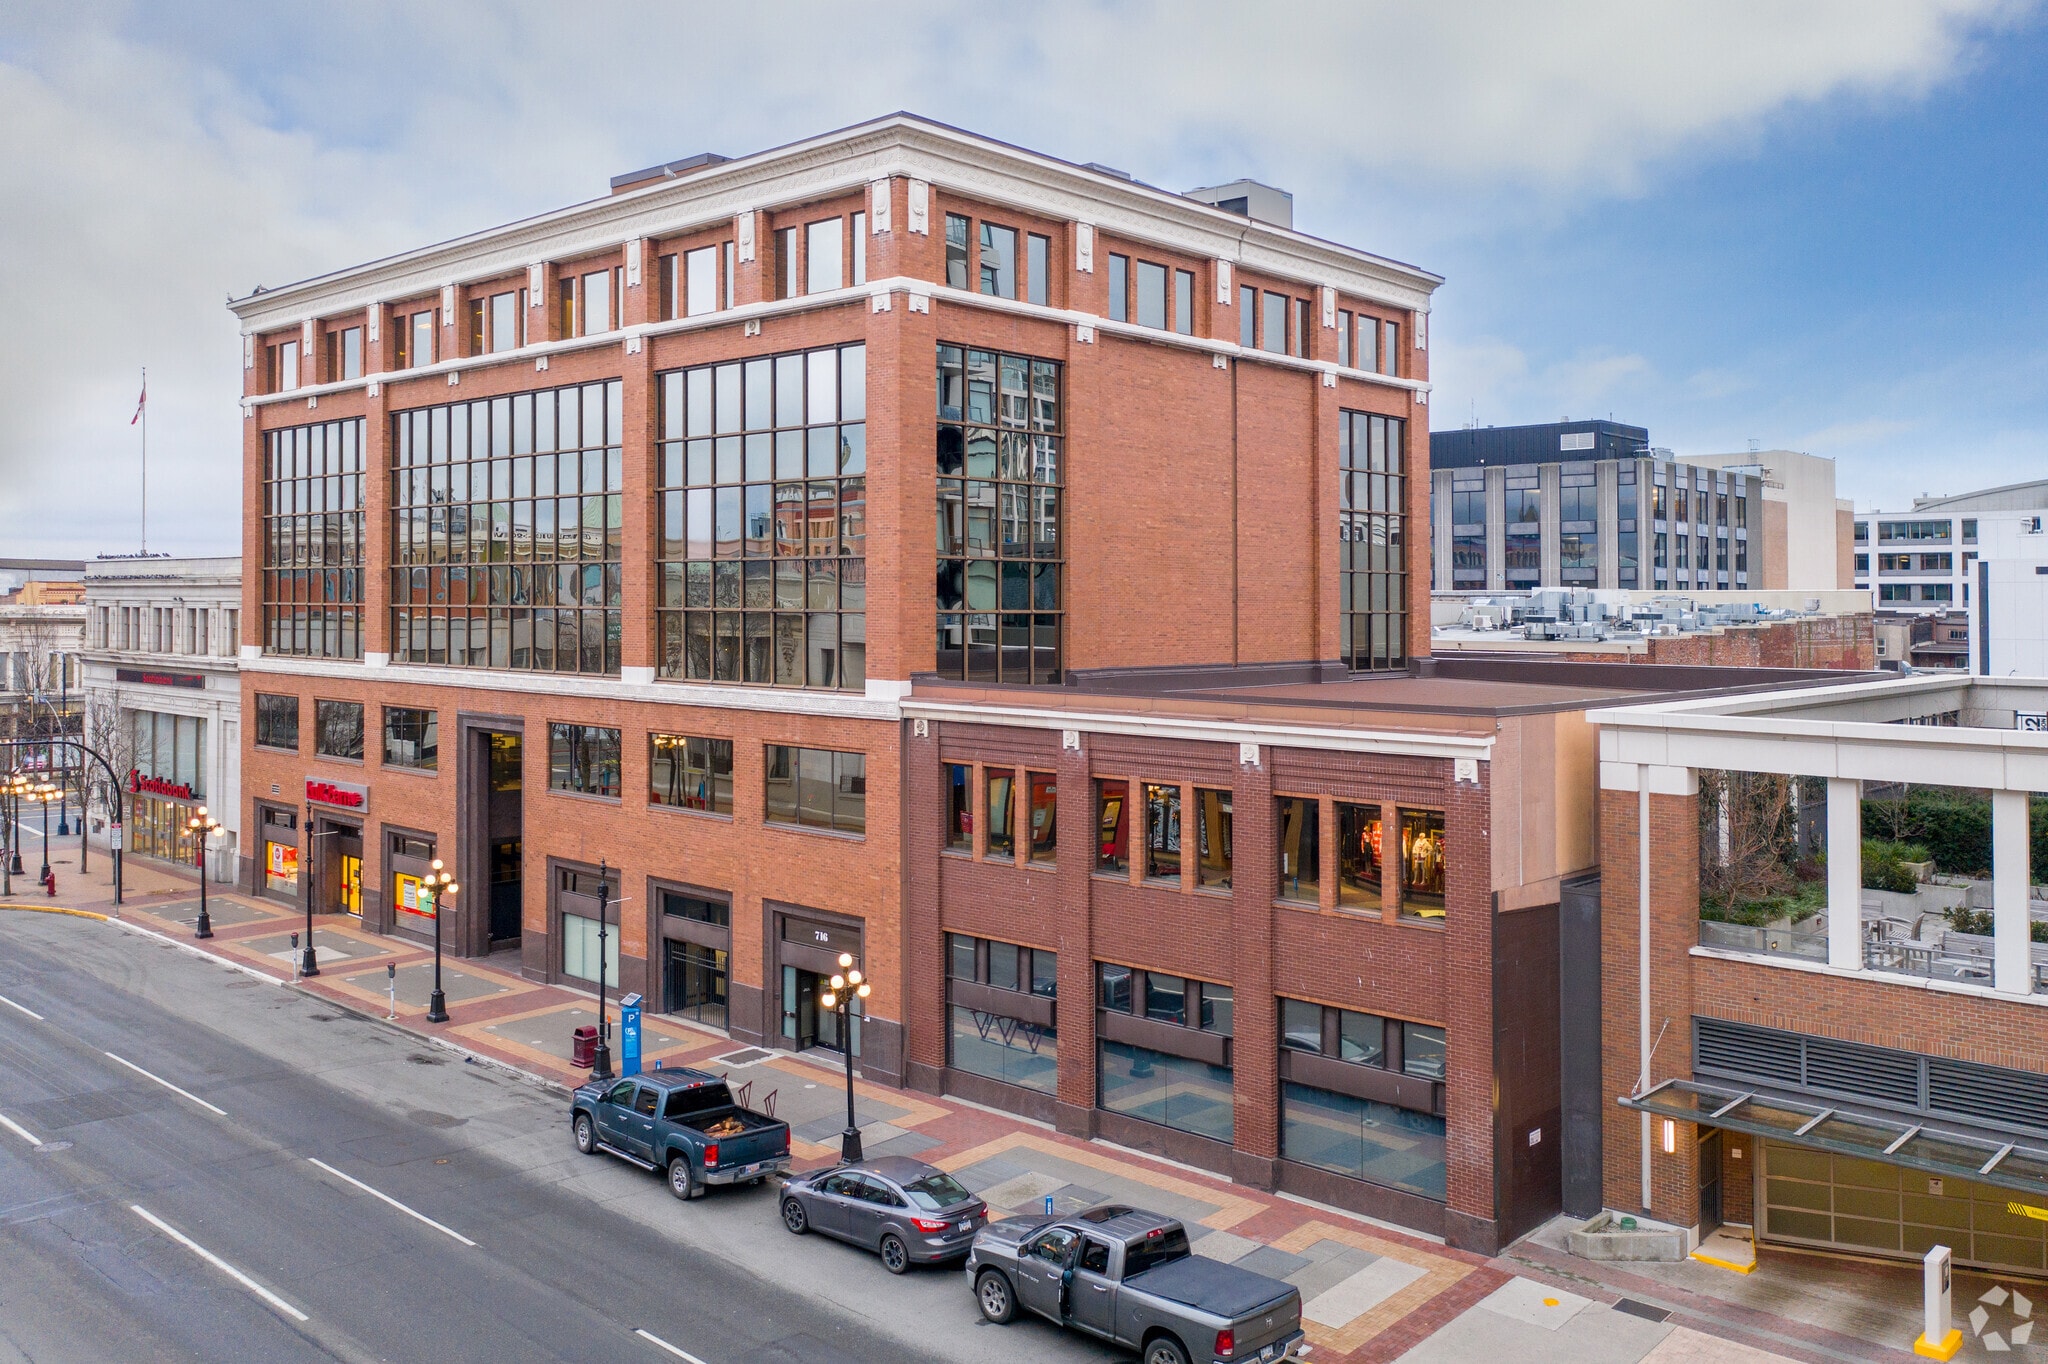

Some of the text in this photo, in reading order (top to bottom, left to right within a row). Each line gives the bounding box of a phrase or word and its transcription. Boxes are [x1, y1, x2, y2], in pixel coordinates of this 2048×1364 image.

[2025, 717, 2040, 731] 2
[140, 774, 191, 800] Scotiabank
[814, 930, 829, 942] 716
[628, 1014, 635, 1023] P
